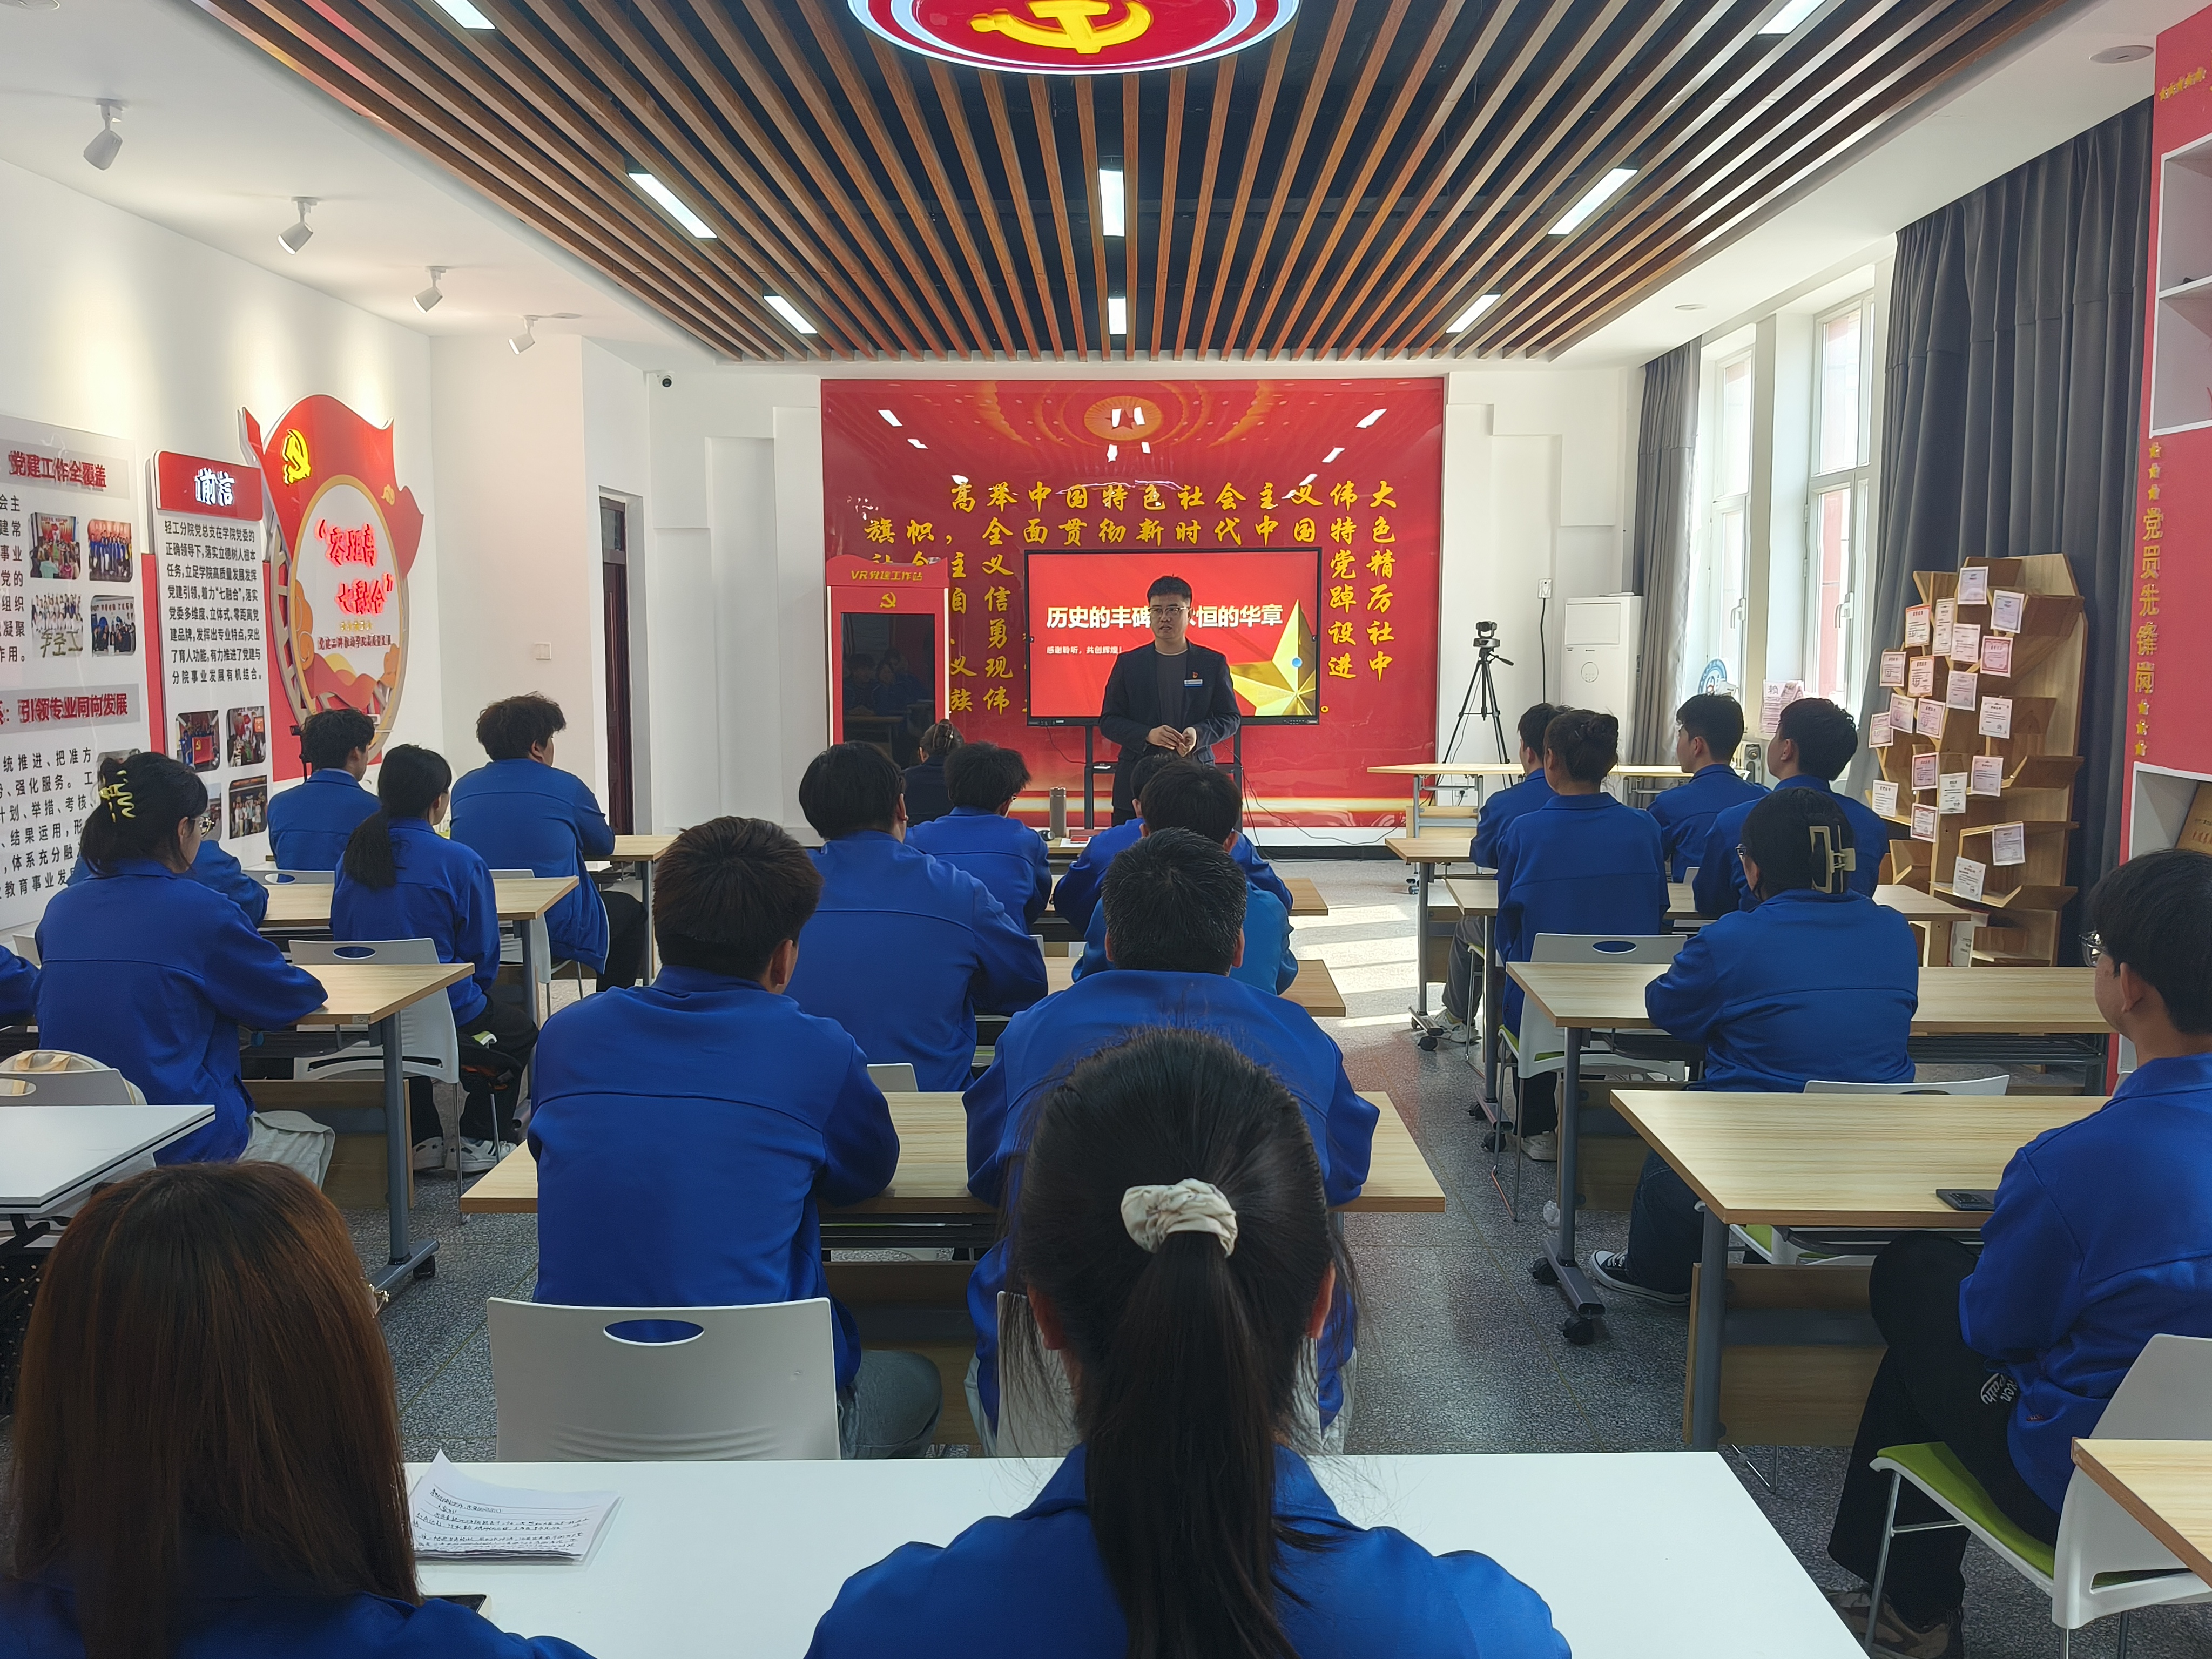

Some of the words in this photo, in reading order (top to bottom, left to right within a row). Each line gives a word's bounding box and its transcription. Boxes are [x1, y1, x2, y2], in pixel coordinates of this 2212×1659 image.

[9, 450, 106, 488] 党建工作全覆盖
[951, 480, 1397, 512] 高举中国特色社会主义伟大
[165, 520, 255, 543] 轻工分院党总支在学院党委的
[0, 544, 22, 562] 事业
[1, 570, 23, 587] 党的
[2, 595, 24, 612] 组织
[2135, 507, 2164, 694] 党员先锋岗
[1046, 605, 1150, 629] 历史的丰碑
[0, 620, 25, 638] 凝聚
